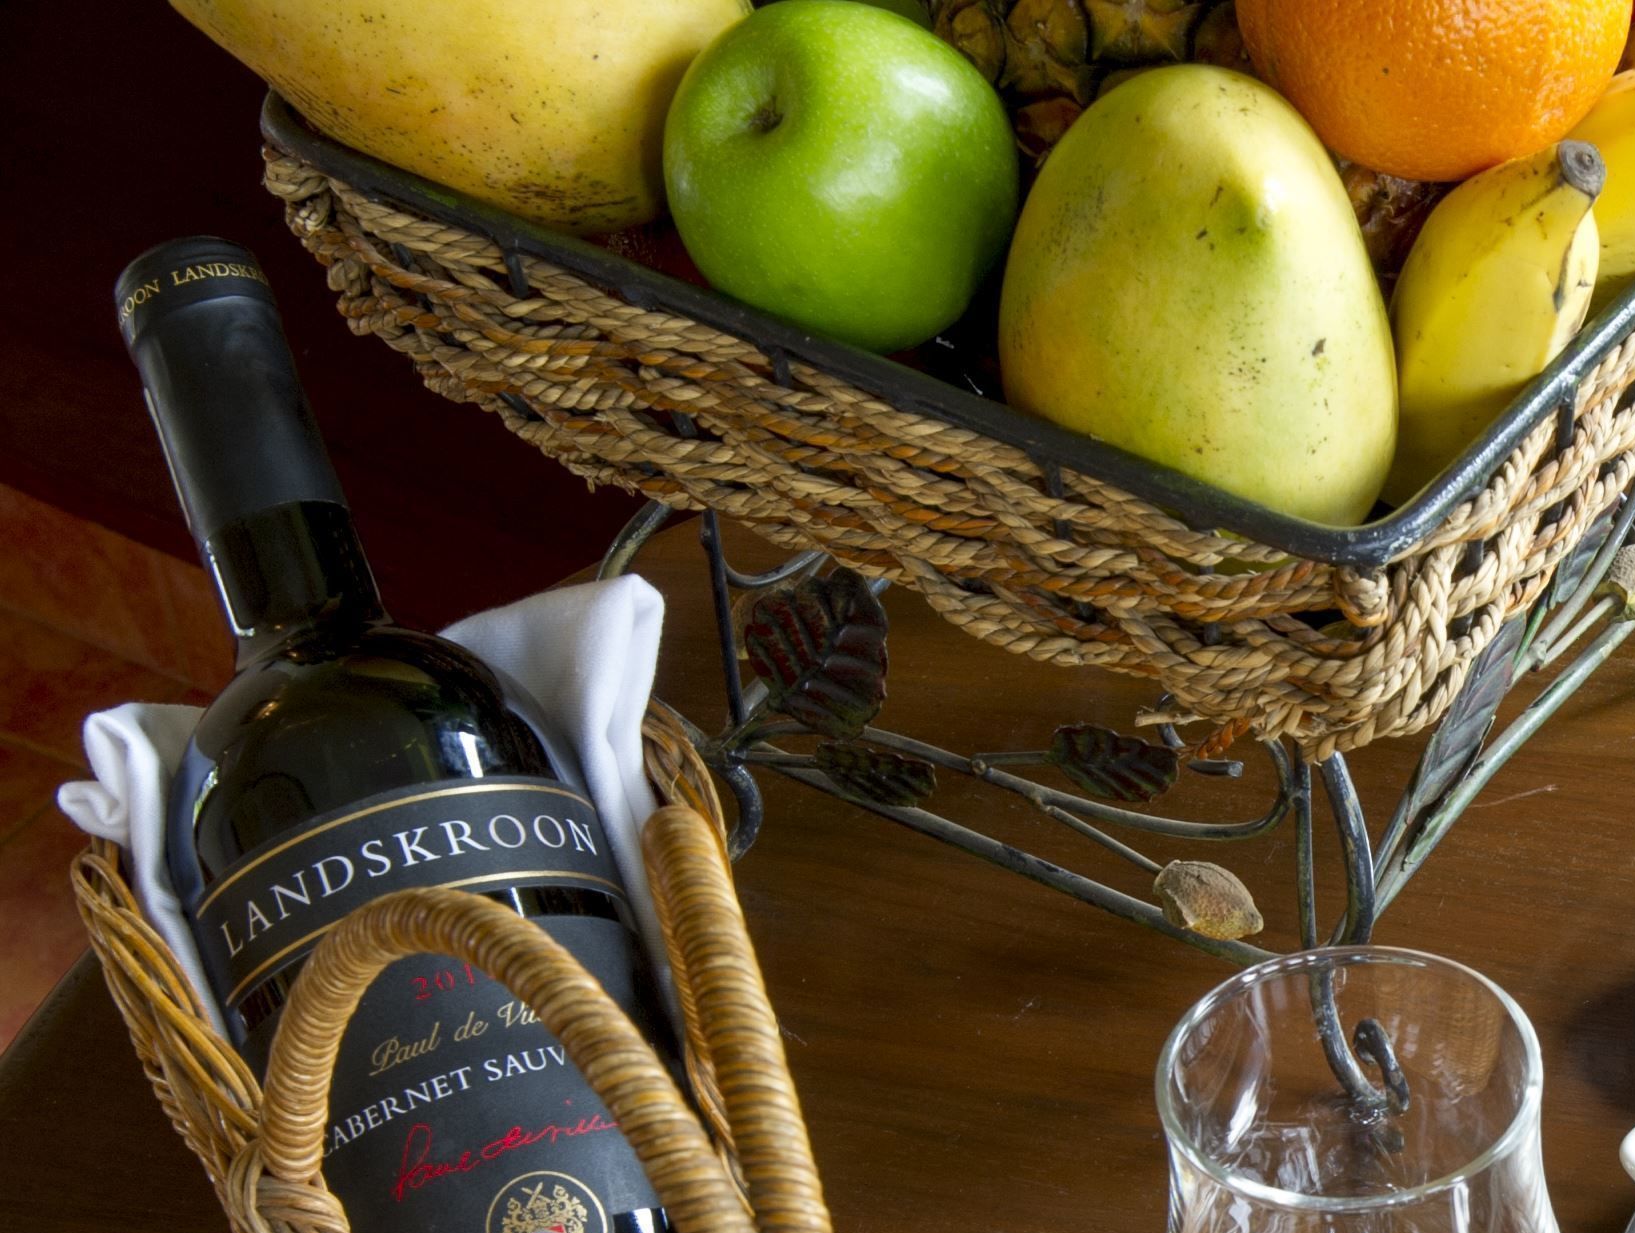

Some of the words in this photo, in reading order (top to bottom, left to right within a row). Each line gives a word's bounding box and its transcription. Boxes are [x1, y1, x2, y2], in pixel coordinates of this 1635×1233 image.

[220, 813, 599, 959] LANDSKROON
[409, 961, 496, 1000] 201
[368, 1021, 441, 1077] Paul
[453, 1011, 489, 1042] de
[483, 1045, 566, 1082] SAUV
